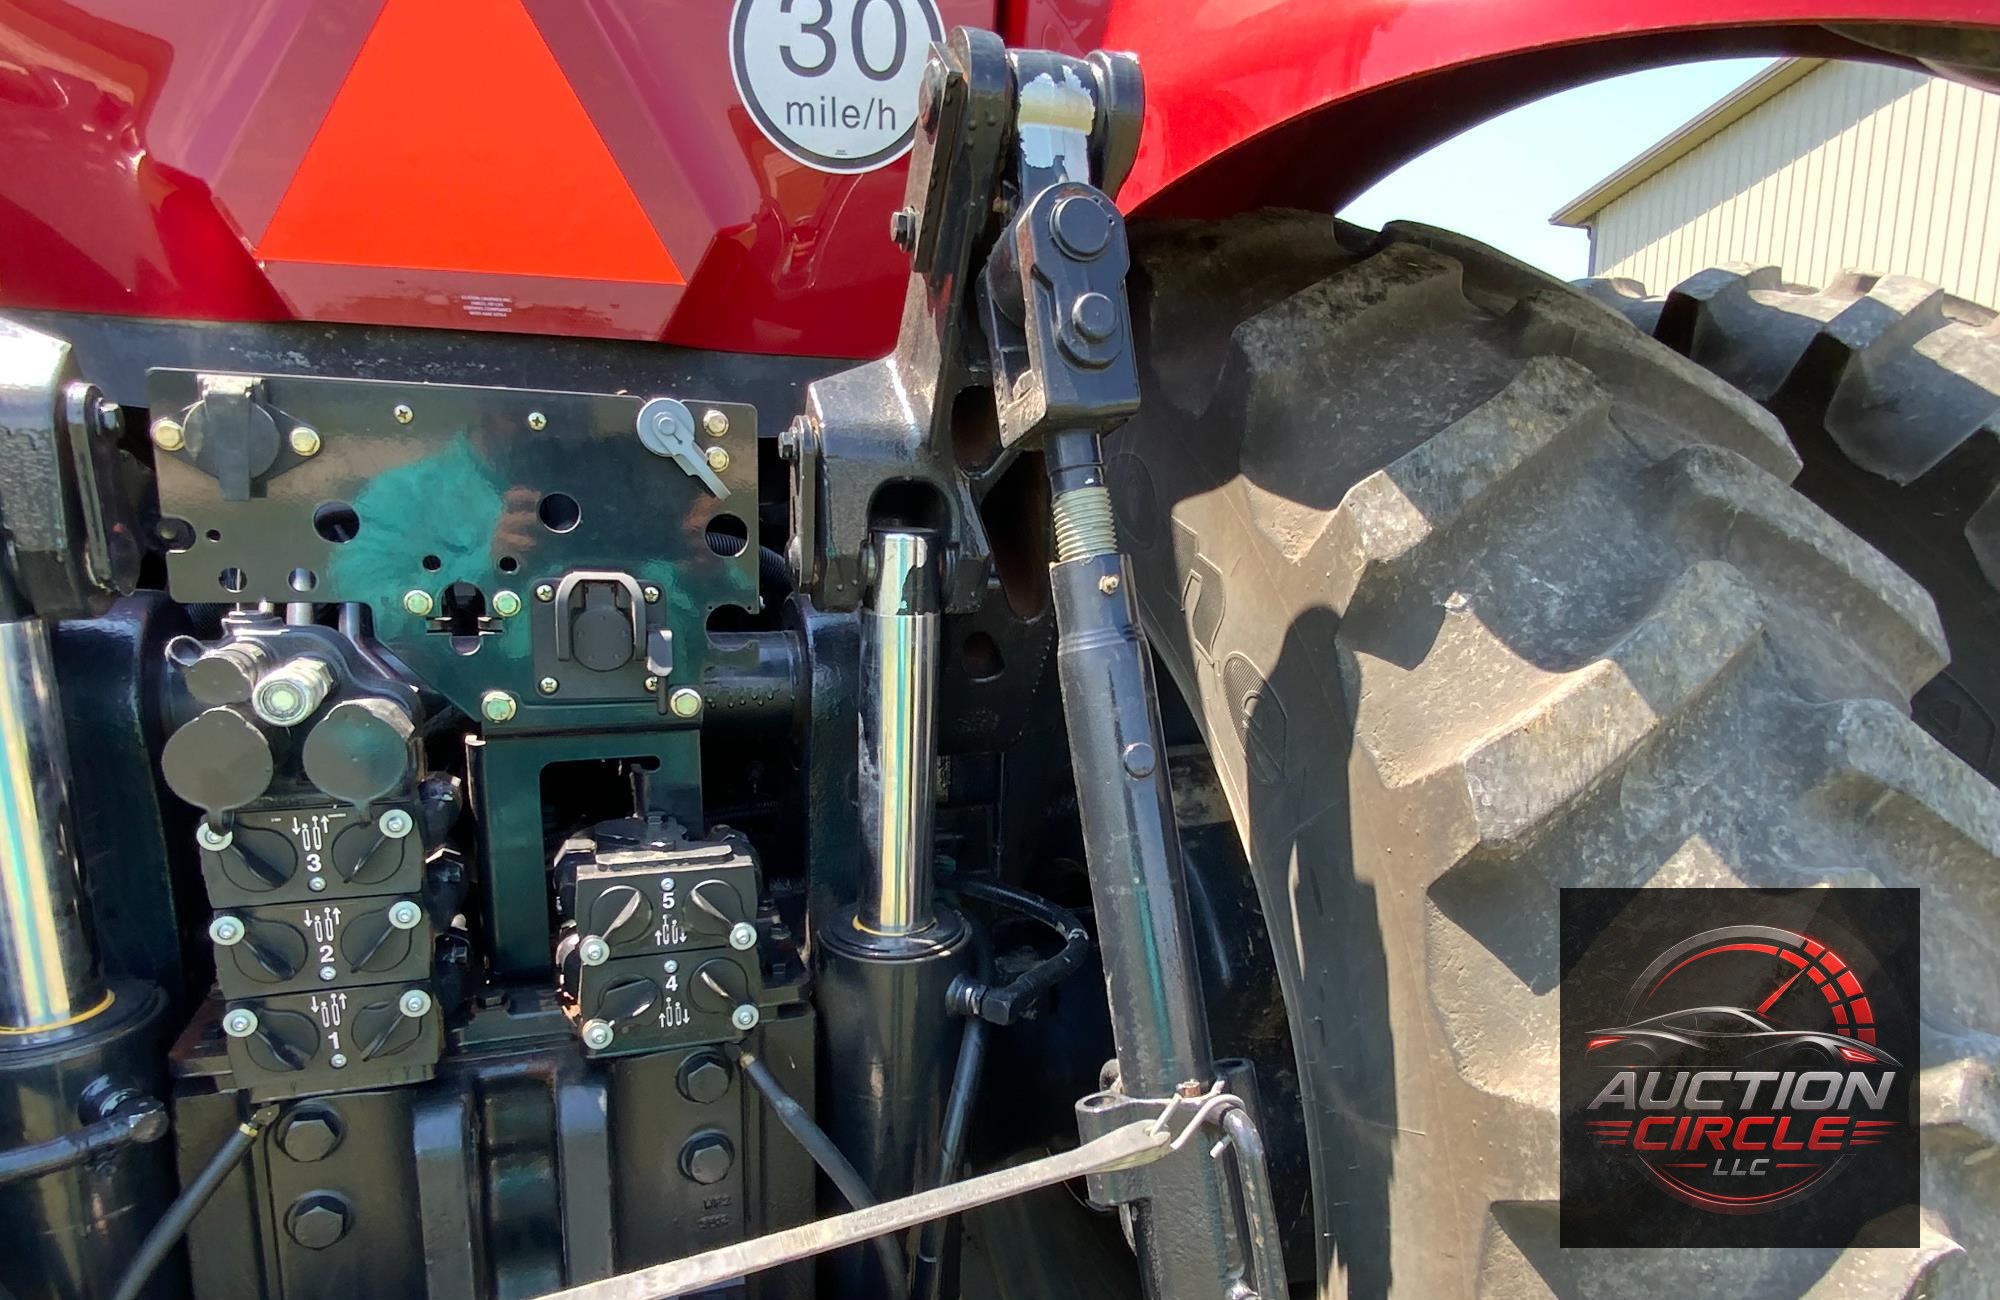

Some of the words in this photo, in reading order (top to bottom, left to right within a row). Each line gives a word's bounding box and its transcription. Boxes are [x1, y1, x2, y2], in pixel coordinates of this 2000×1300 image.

[778, 0, 907, 82] 30
[786, 96, 896, 130] mile/h
[306, 853, 322, 872] 3
[662, 892, 675, 909] 5
[319, 944, 335, 963] 2
[665, 975, 678, 992] 4
[328, 1031, 340, 1050] 1
